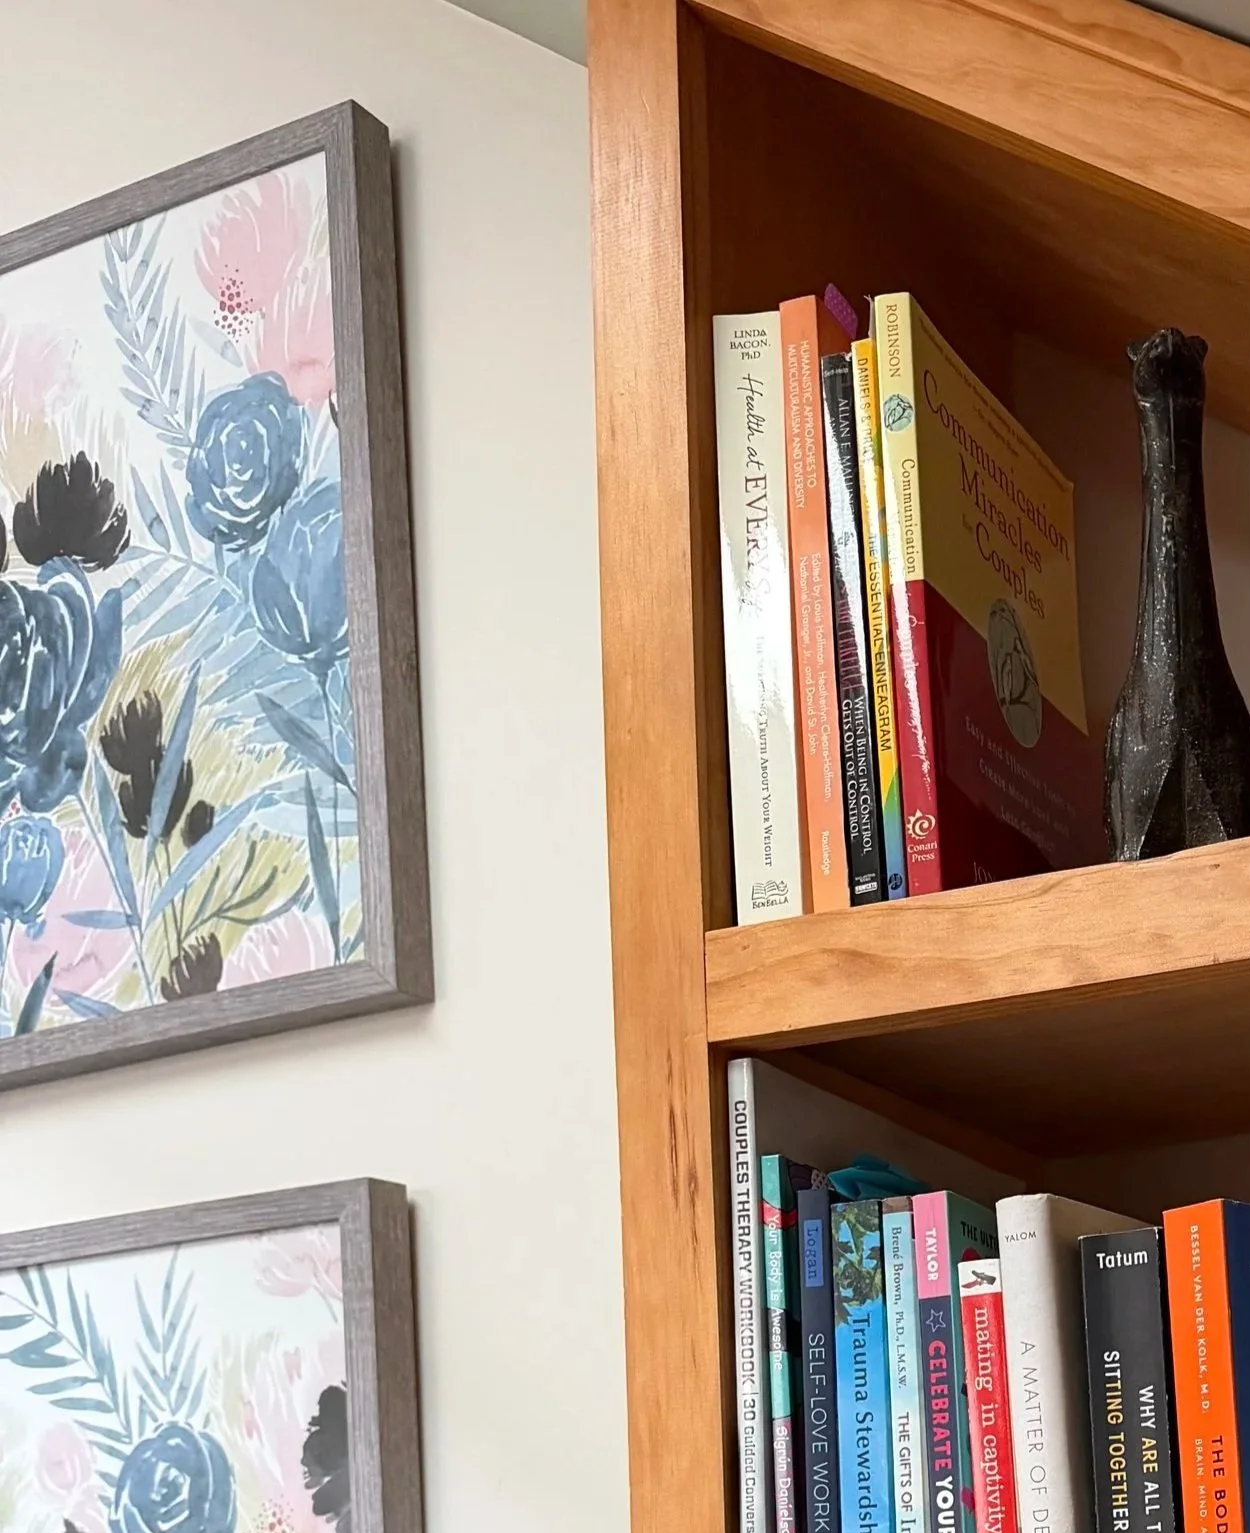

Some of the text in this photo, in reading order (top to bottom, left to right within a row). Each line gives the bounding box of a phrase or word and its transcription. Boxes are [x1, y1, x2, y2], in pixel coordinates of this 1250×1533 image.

[734, 329, 767, 338] LINDA
[741, 350, 761, 360] PhD
[886, 303, 901, 378] ROBINSON
[737, 373, 764, 471] Health at
[901, 458, 919, 574] Communication
[869, 562, 886, 641] ESSENTIAL
[855, 696, 864, 735] WHEN
[874, 650, 892, 751] ENNEAGRAM
[857, 740, 867, 776] BEING
[859, 778, 867, 792] IN
[860, 796, 872, 854] CONTROL
[908, 842, 937, 853] Conari
[912, 852, 935, 862] Press
[734, 1100, 756, 1386] COUPLES THERAPY WORKBOOK
[806, 1227, 819, 1279] Logan
[925, 1227, 939, 1281] TAYLOR
[1004, 1231, 1037, 1243] YALOM
[1096, 1250, 1148, 1269] Tatum
[852, 1312, 872, 1403] Trauma
[974, 1307, 995, 1391] mating
[808, 1333, 828, 1454] SELF-LOVE
[928, 1340, 952, 1472] CELEBRATE
[982, 1403, 1000, 1426] in
[1138, 1385, 1156, 1429] WHY
[1140, 1438, 1159, 1474] ARE
[1211, 1435, 1225, 1478] THE
[1143, 1481, 1162, 1515] ALL
